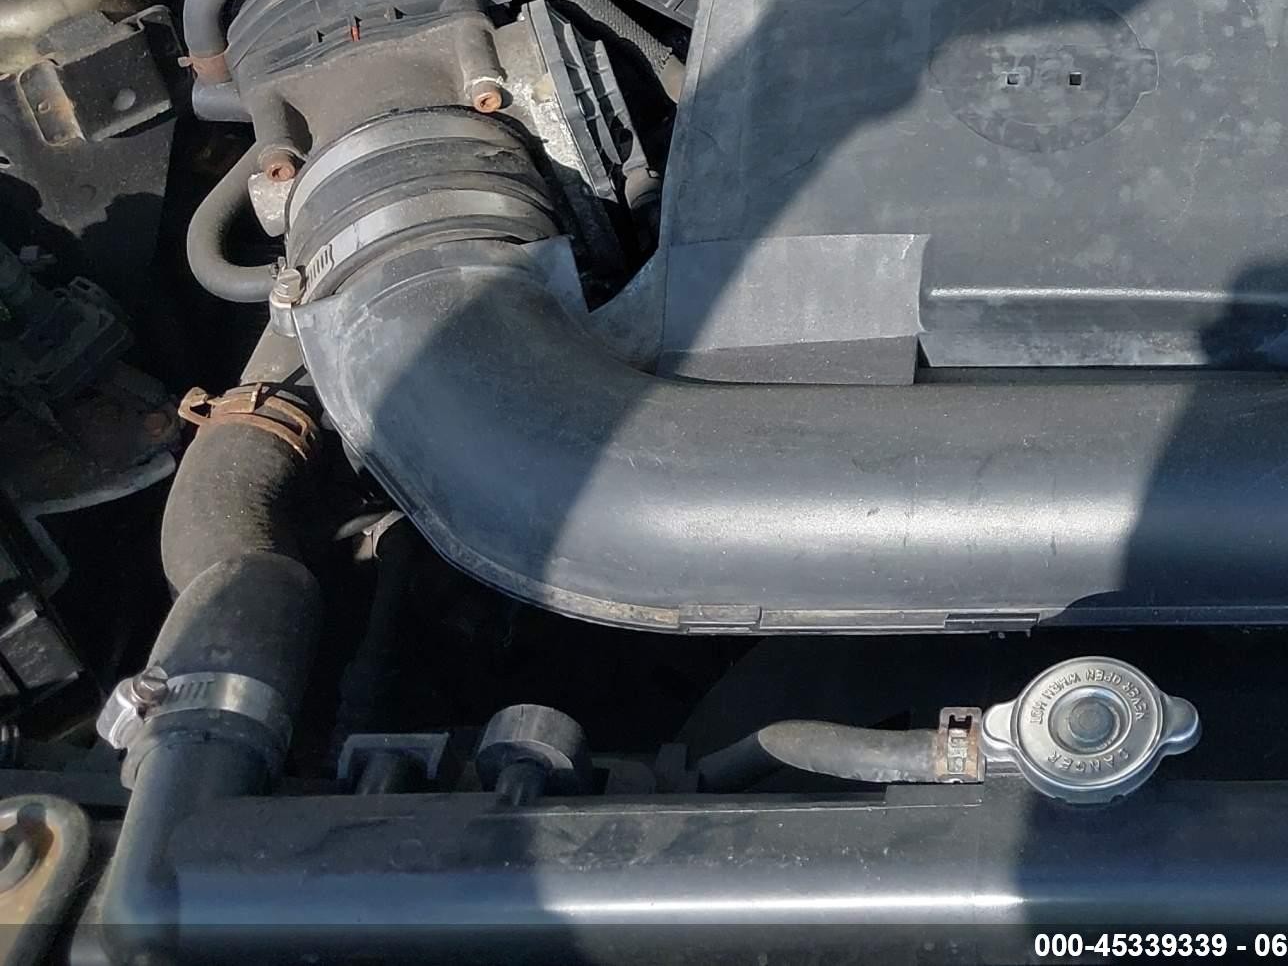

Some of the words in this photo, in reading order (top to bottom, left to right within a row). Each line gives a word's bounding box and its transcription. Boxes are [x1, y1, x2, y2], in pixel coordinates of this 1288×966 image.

[1042, 673, 1082, 701] WHEN
[1086, 669, 1122, 685] OPEN
[1031, 700, 1047, 725] HOT
[1048, 748, 1129, 772] DANGER
